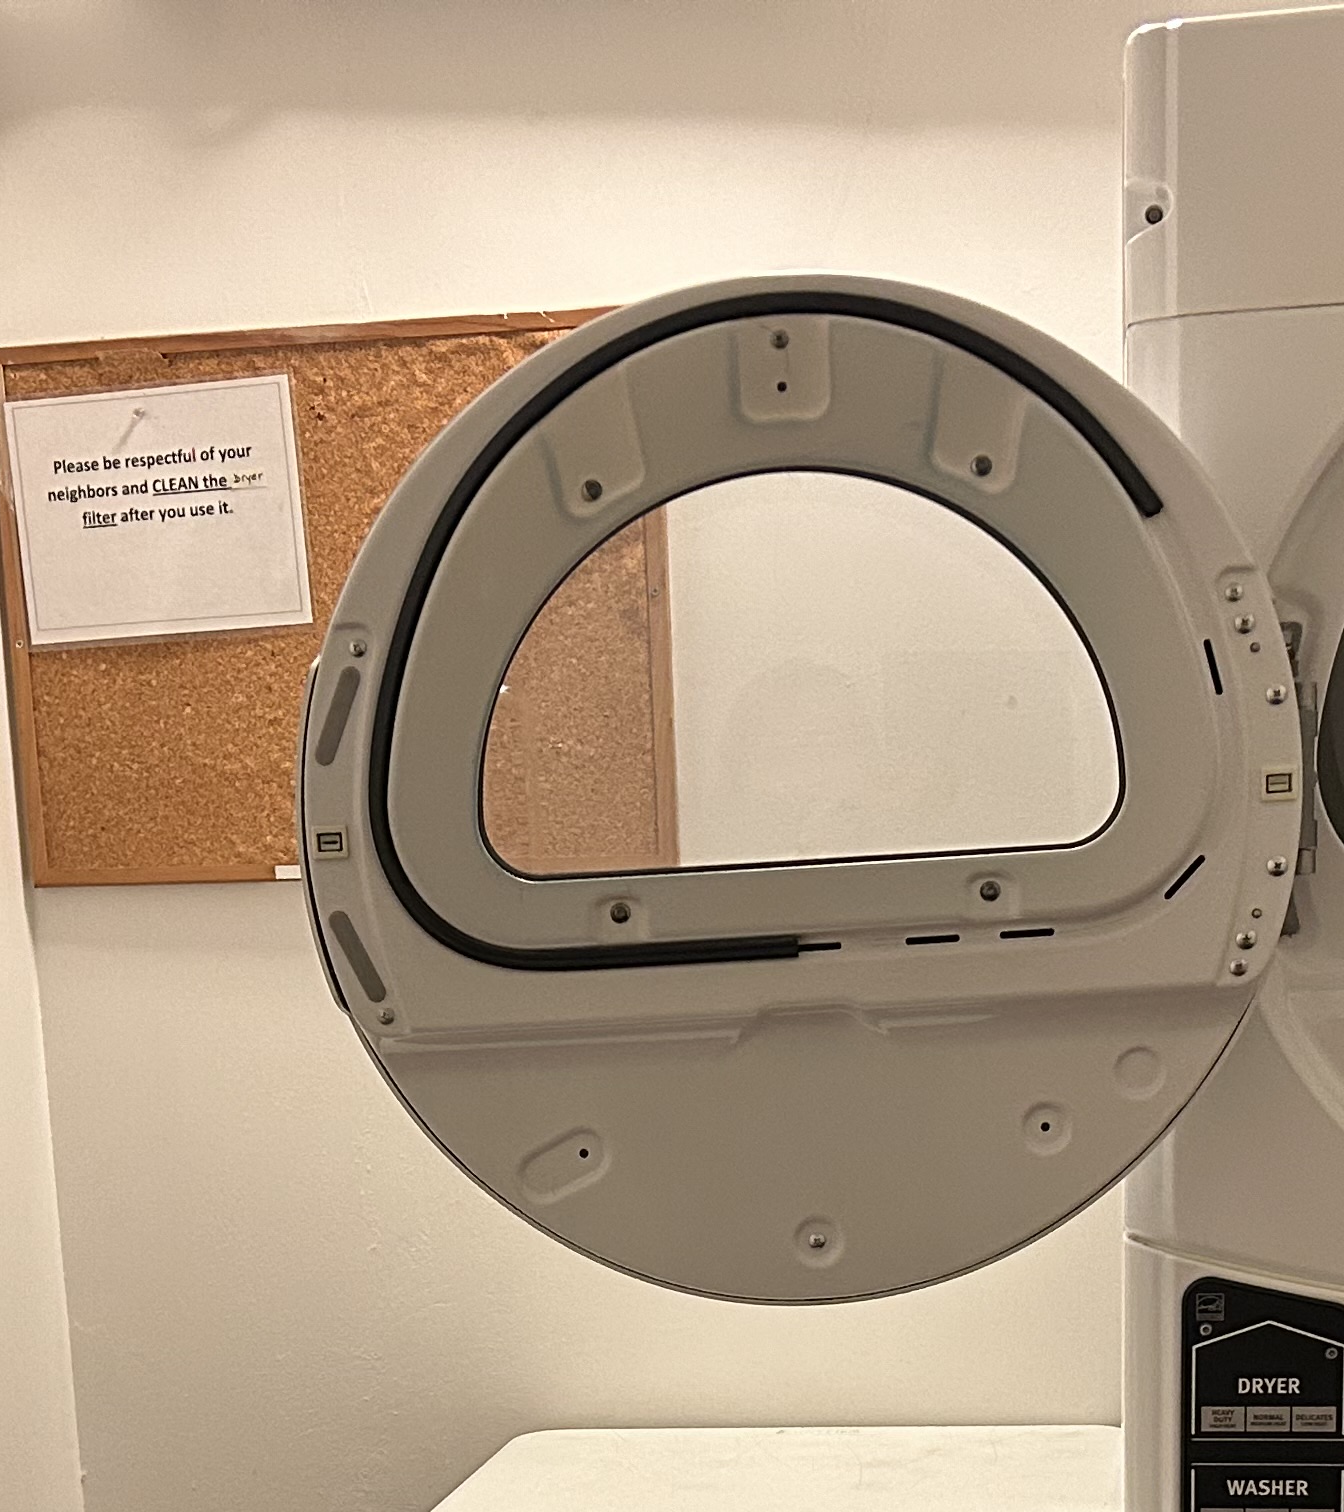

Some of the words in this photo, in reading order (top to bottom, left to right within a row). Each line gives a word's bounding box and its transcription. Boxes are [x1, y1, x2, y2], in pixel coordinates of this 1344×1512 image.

[53, 459, 99, 474] Please
[103, 456, 121, 470] be
[124, 447, 197, 472] respectful
[200, 446, 216, 462] of
[218, 445, 252, 466] your
[47, 484, 118, 503] neighbors
[121, 480, 148, 495] and
[152, 475, 199, 493] CLEAN
[202, 474, 227, 489] the
[82, 511, 117, 526] filter
[120, 508, 154, 523] after
[158, 506, 186, 521] you
[189, 503, 214, 517] use
[218, 500, 234, 514] it.
[1237, 1377, 1301, 1395] DRYER
[1226, 1479, 1309, 1496] WASHER
